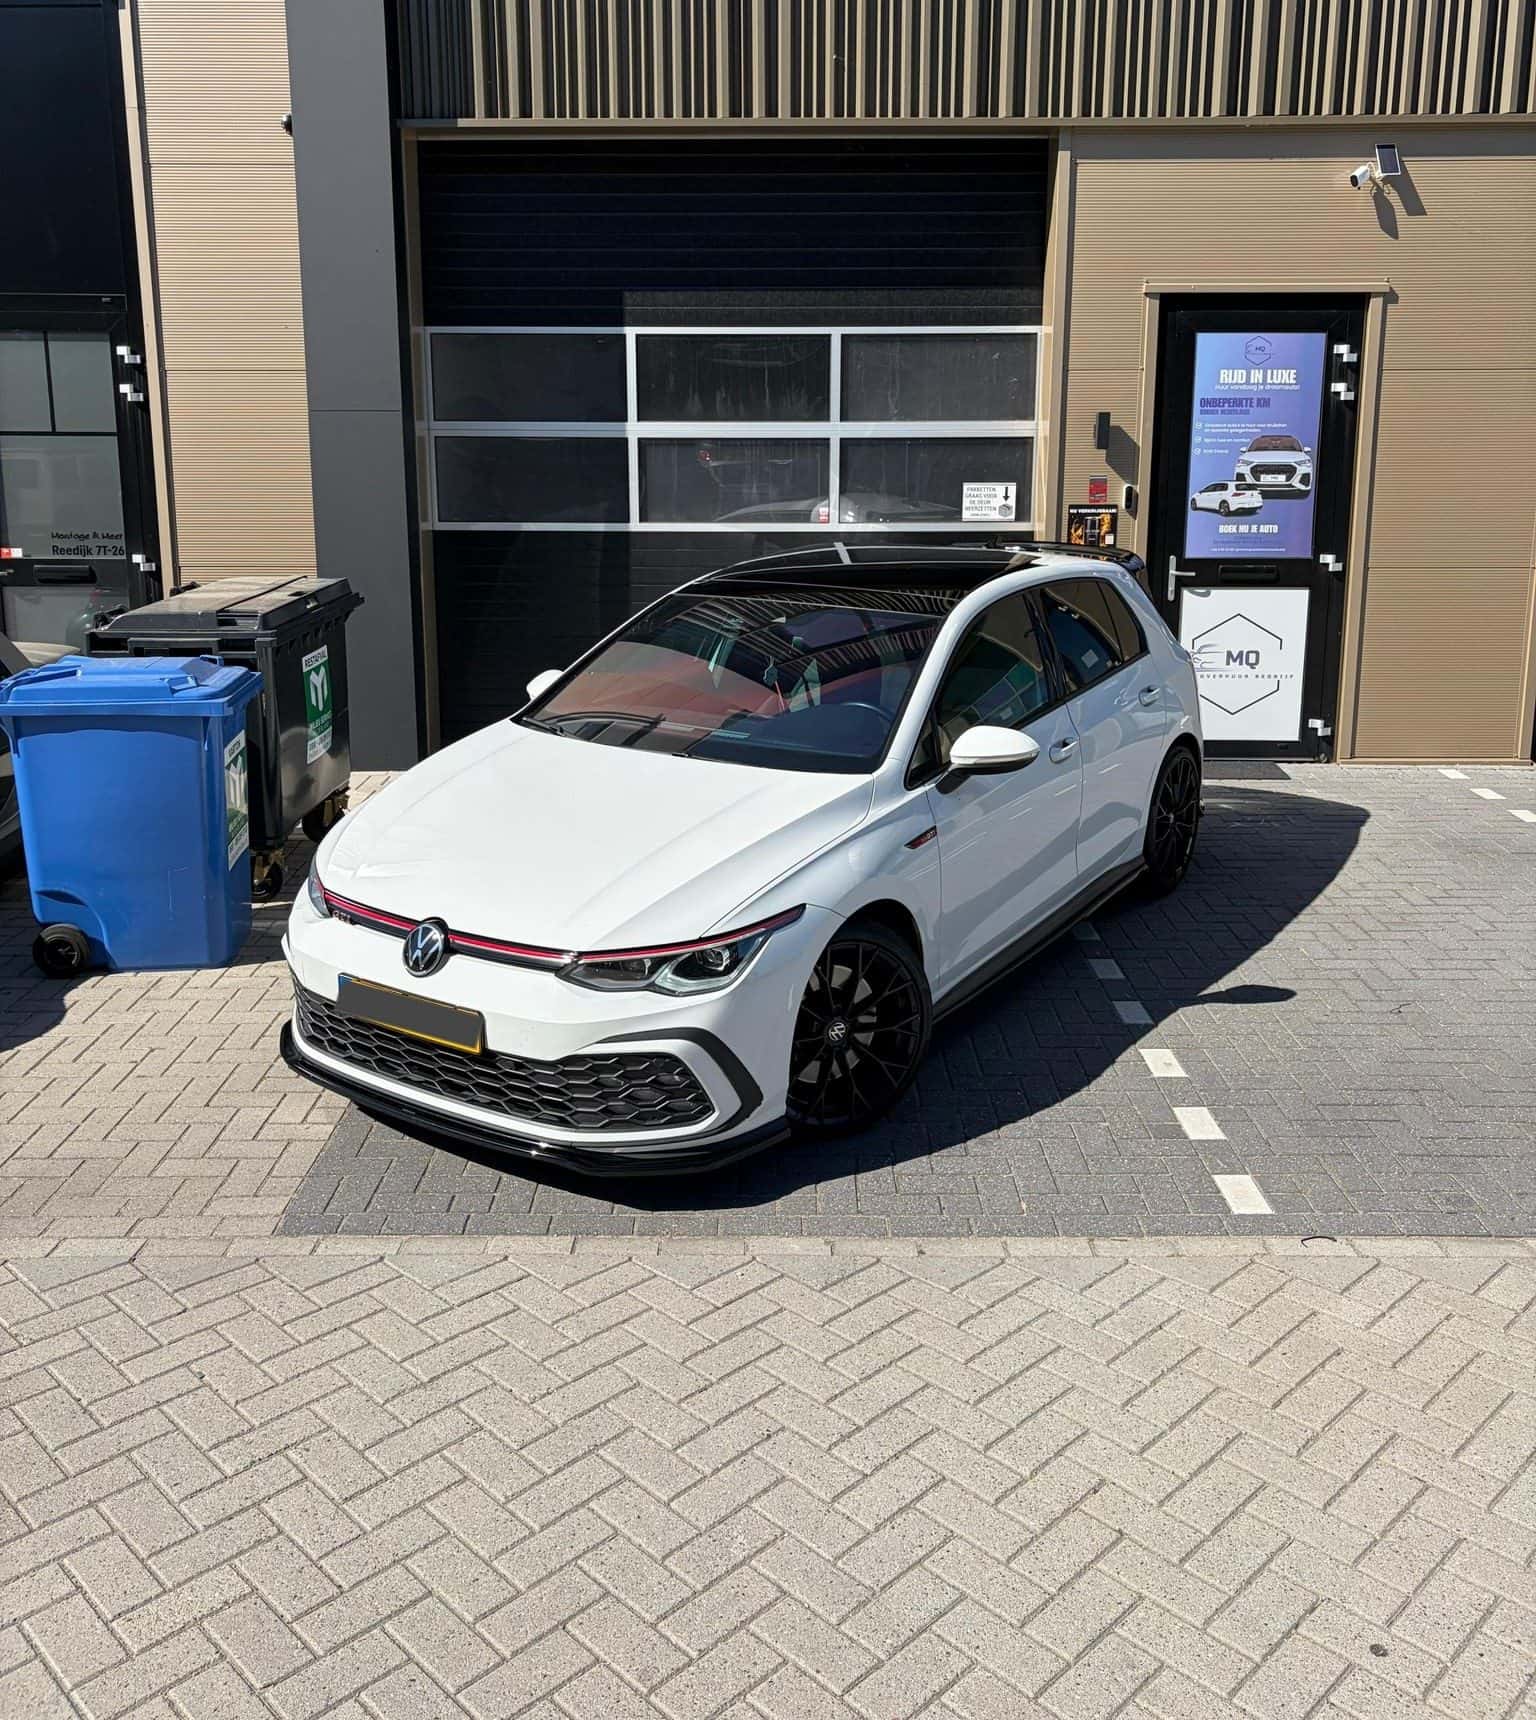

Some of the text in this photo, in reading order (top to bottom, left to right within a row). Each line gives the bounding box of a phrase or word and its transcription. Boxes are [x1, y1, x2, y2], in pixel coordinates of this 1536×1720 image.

[1219, 369, 1296, 384] RIJD IN LUXE
[1200, 397, 1271, 408] ONBEPERKTE KM
[1218, 524, 1279, 533] BOEK NU JE AUTO
[52, 544, 125, 557] Reedijk 7T-26
[1225, 650, 1260, 669] MQ
